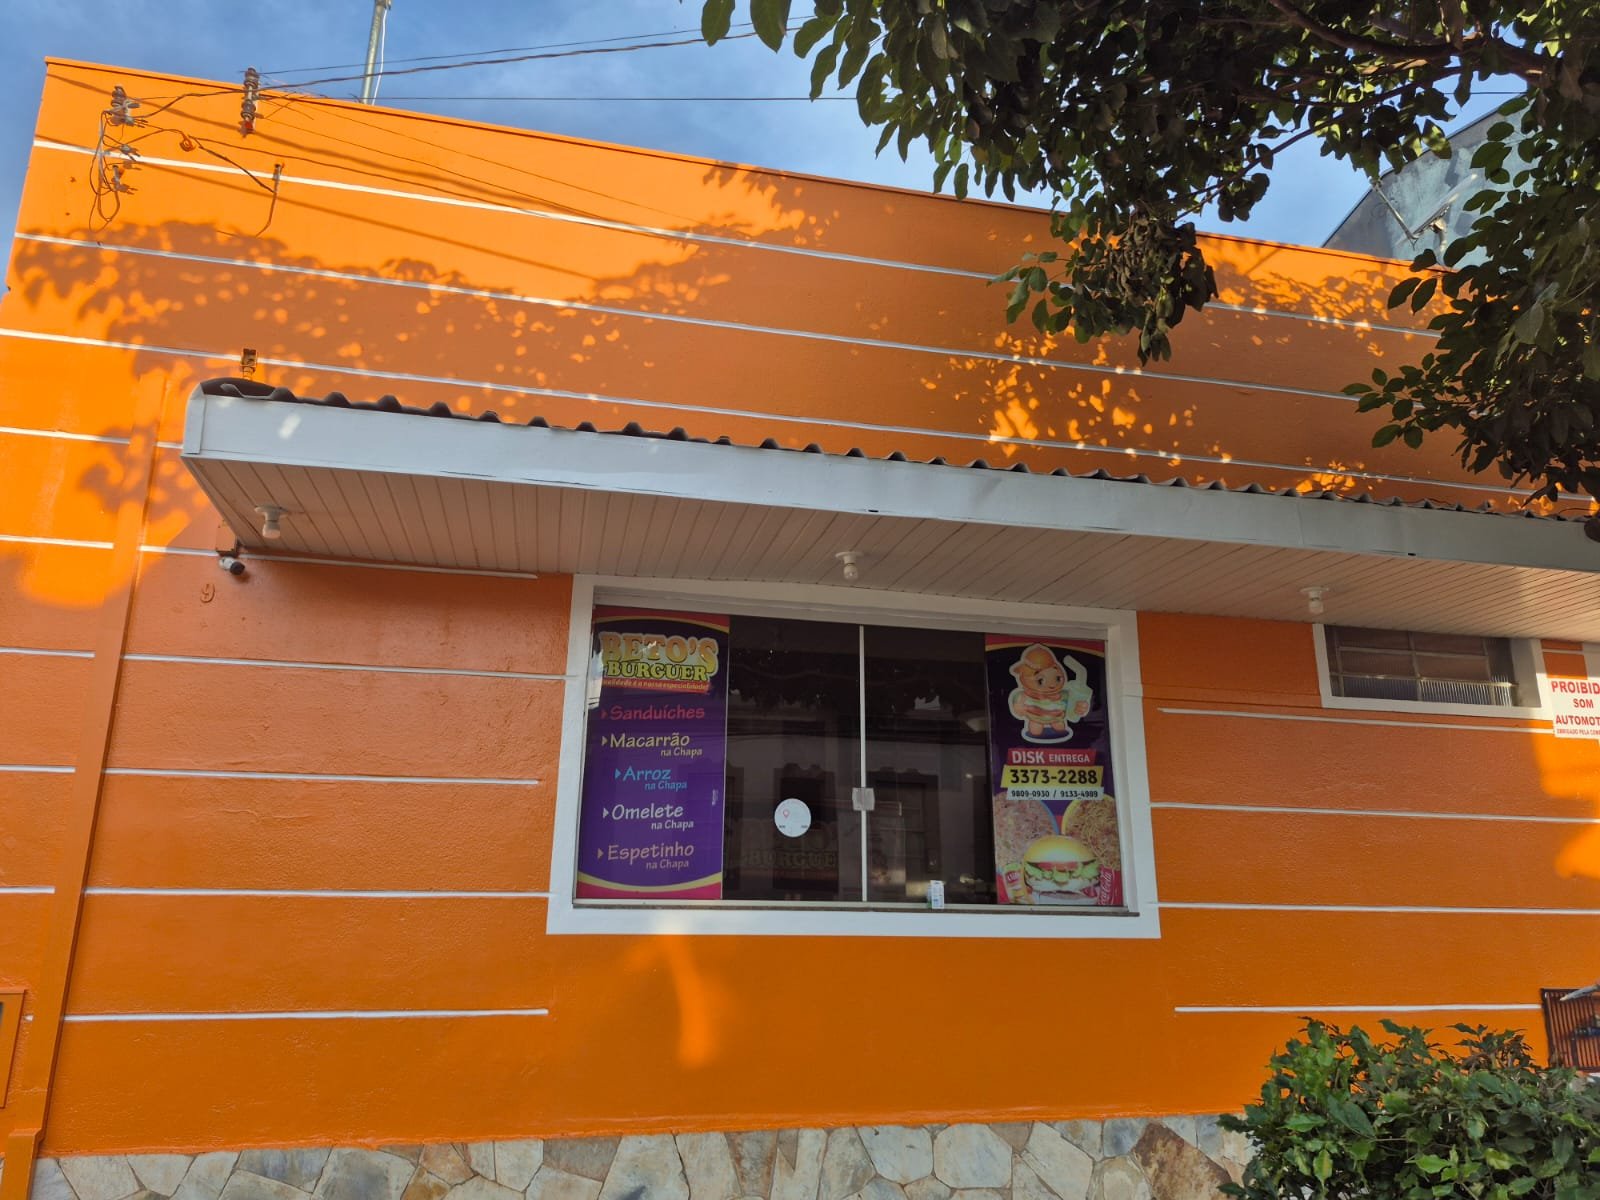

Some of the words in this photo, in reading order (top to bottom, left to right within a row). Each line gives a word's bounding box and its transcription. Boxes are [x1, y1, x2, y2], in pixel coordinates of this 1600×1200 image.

[600, 632, 718, 674] BETO'S
[607, 660, 708, 682] BURGUER
[1551, 680, 1600, 695] PROIBID
[1573, 698, 1594, 709] SOM
[609, 704, 705, 721] Sanduíches
[609, 732, 690, 748] Macarrão
[673, 747, 703, 759] Chapa
[1011, 750, 1046, 764] DISK
[1048, 753, 1090, 763] ENTREGA
[622, 765, 672, 781] Arroz
[1009, 769, 1098, 784] 3373-2288
[644, 782, 656, 790] na
[658, 780, 688, 792] Chapa
[611, 803, 684, 820] Omelete
[651, 822, 663, 830] na
[664, 819, 695, 831] Chapa
[607, 841, 695, 865] Espetinho
[646, 862, 658, 870] na
[660, 859, 689, 871] Chapa
